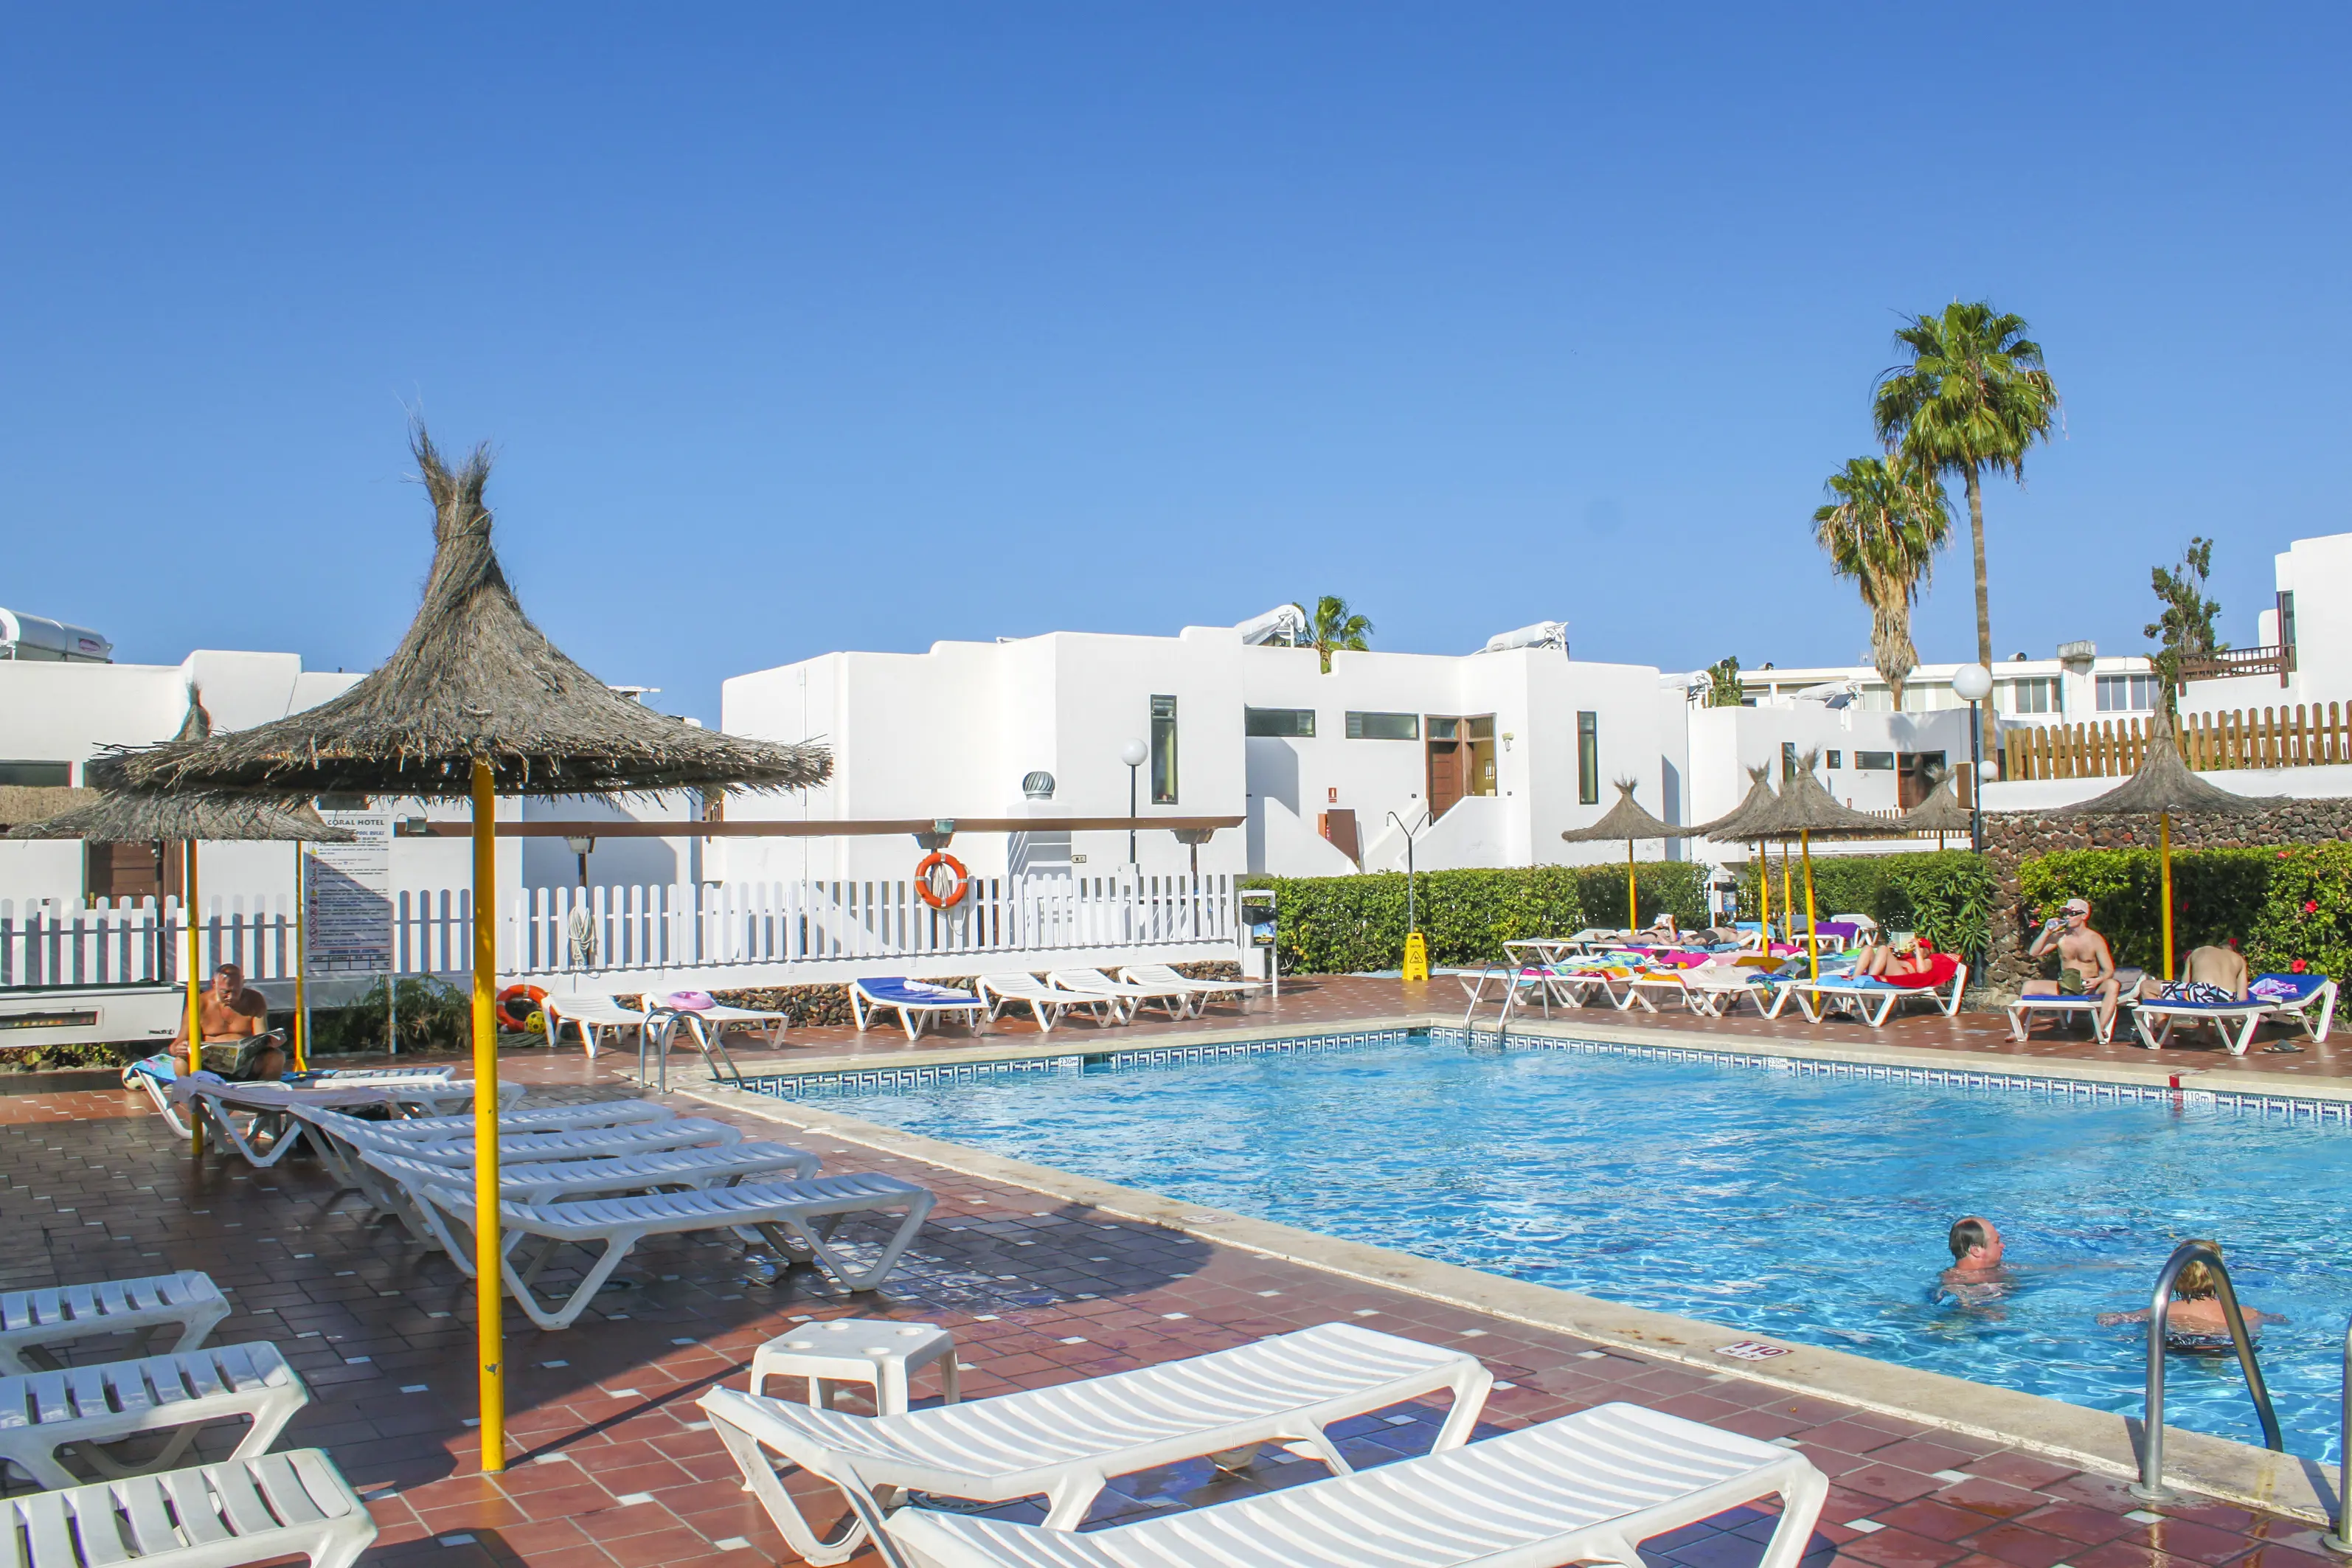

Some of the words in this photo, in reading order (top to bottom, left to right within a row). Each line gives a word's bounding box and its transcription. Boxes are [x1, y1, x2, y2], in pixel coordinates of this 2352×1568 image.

[1769, 1058, 1786, 1066] 230m
[2185, 1092, 2210, 1102] 110m
[1734, 1342, 1784, 1356] 110
